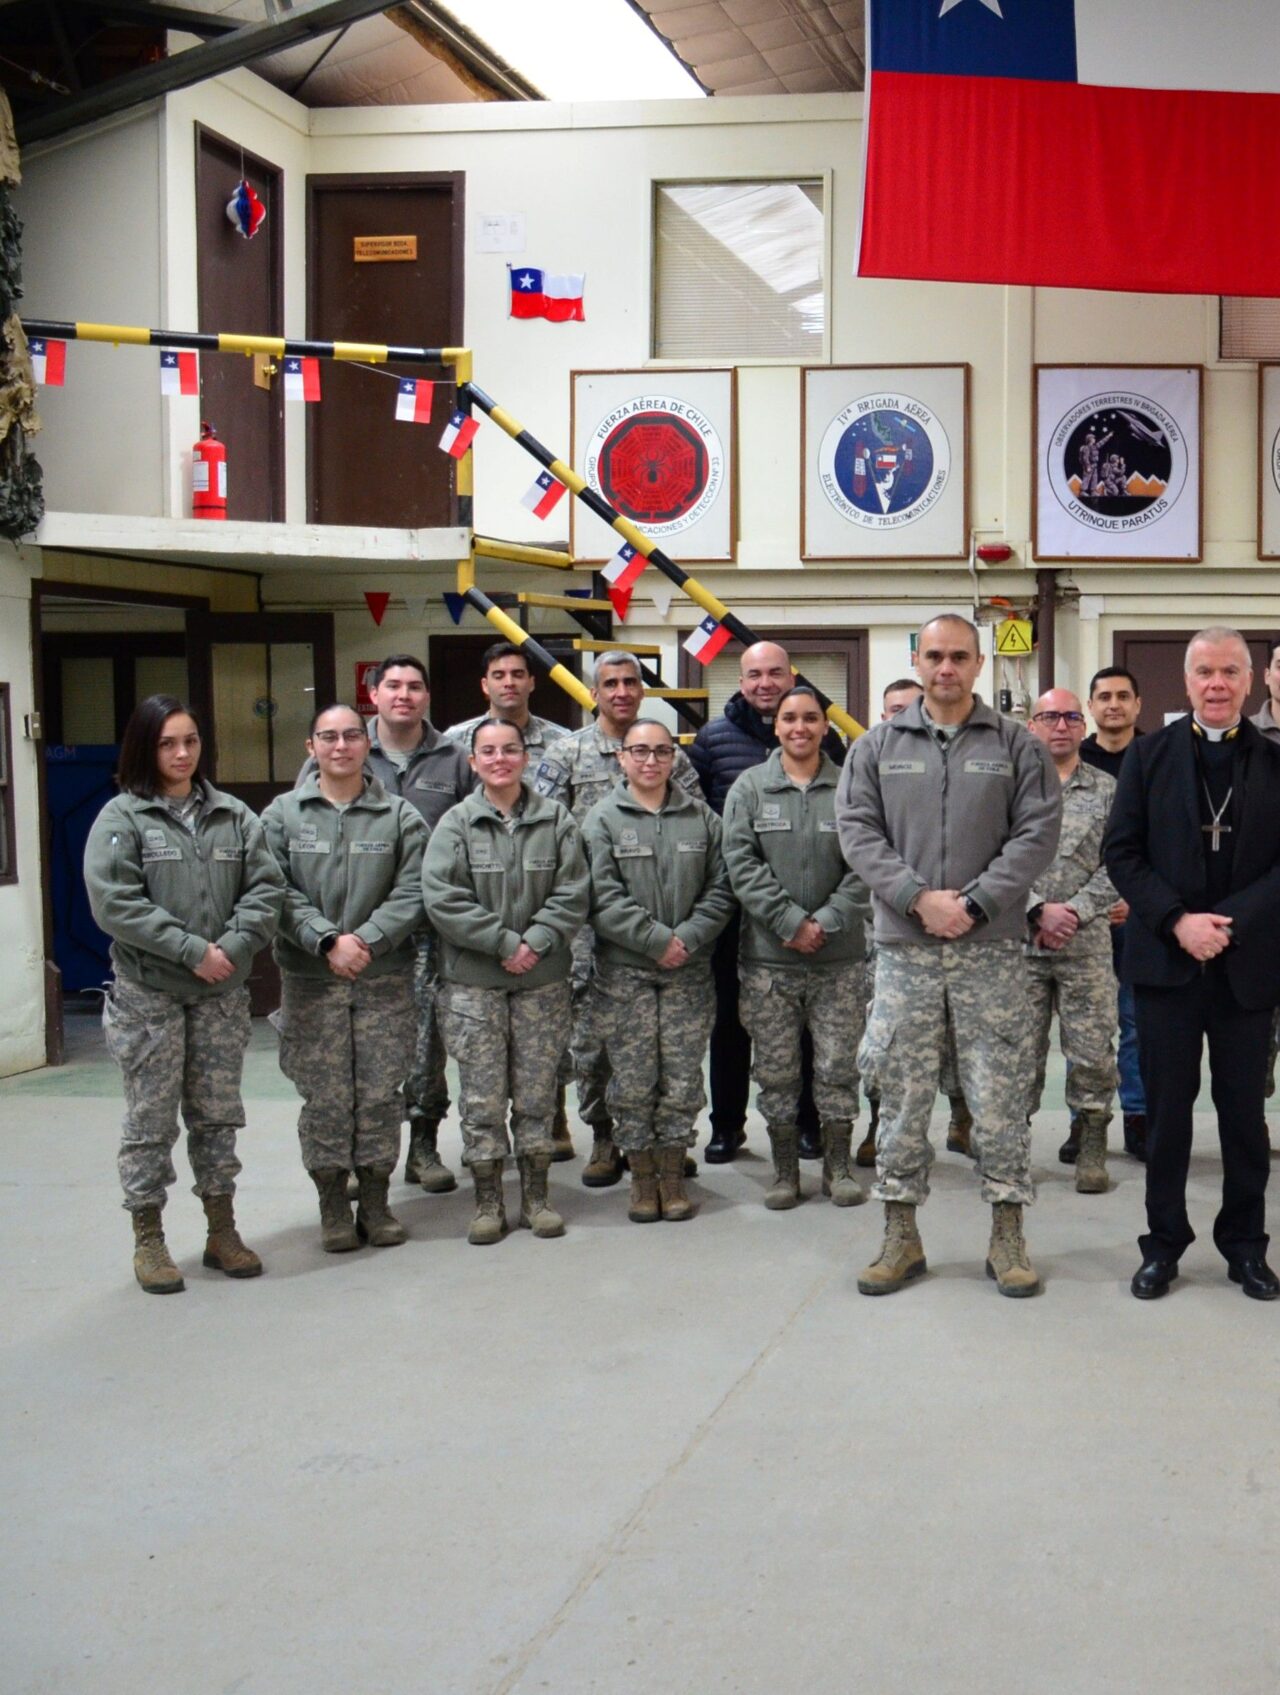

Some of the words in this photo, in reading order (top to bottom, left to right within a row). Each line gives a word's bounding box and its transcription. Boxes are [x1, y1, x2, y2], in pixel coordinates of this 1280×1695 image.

[597, 407, 630, 439] FUERZA
[670, 402, 685, 414] DE
[686, 409, 712, 437] CHILE
[857, 399, 899, 412] BRIGADA
[904, 403, 931, 425] AÉREA
[1055, 405, 1091, 447] OBSERVADORES
[1091, 396, 1132, 408] TERRESTRES
[1140, 401, 1166, 423] BRIGADA
[588, 457, 596, 487] GRUPO
[822, 474, 860, 519] ELECTRÓNICO
[862, 516, 872, 524] DE
[878, 470, 946, 525] TELECOMUNICACIONES
[1068, 500, 1120, 529] UTRINQUE
[1122, 498, 1168, 528] PARATUS
